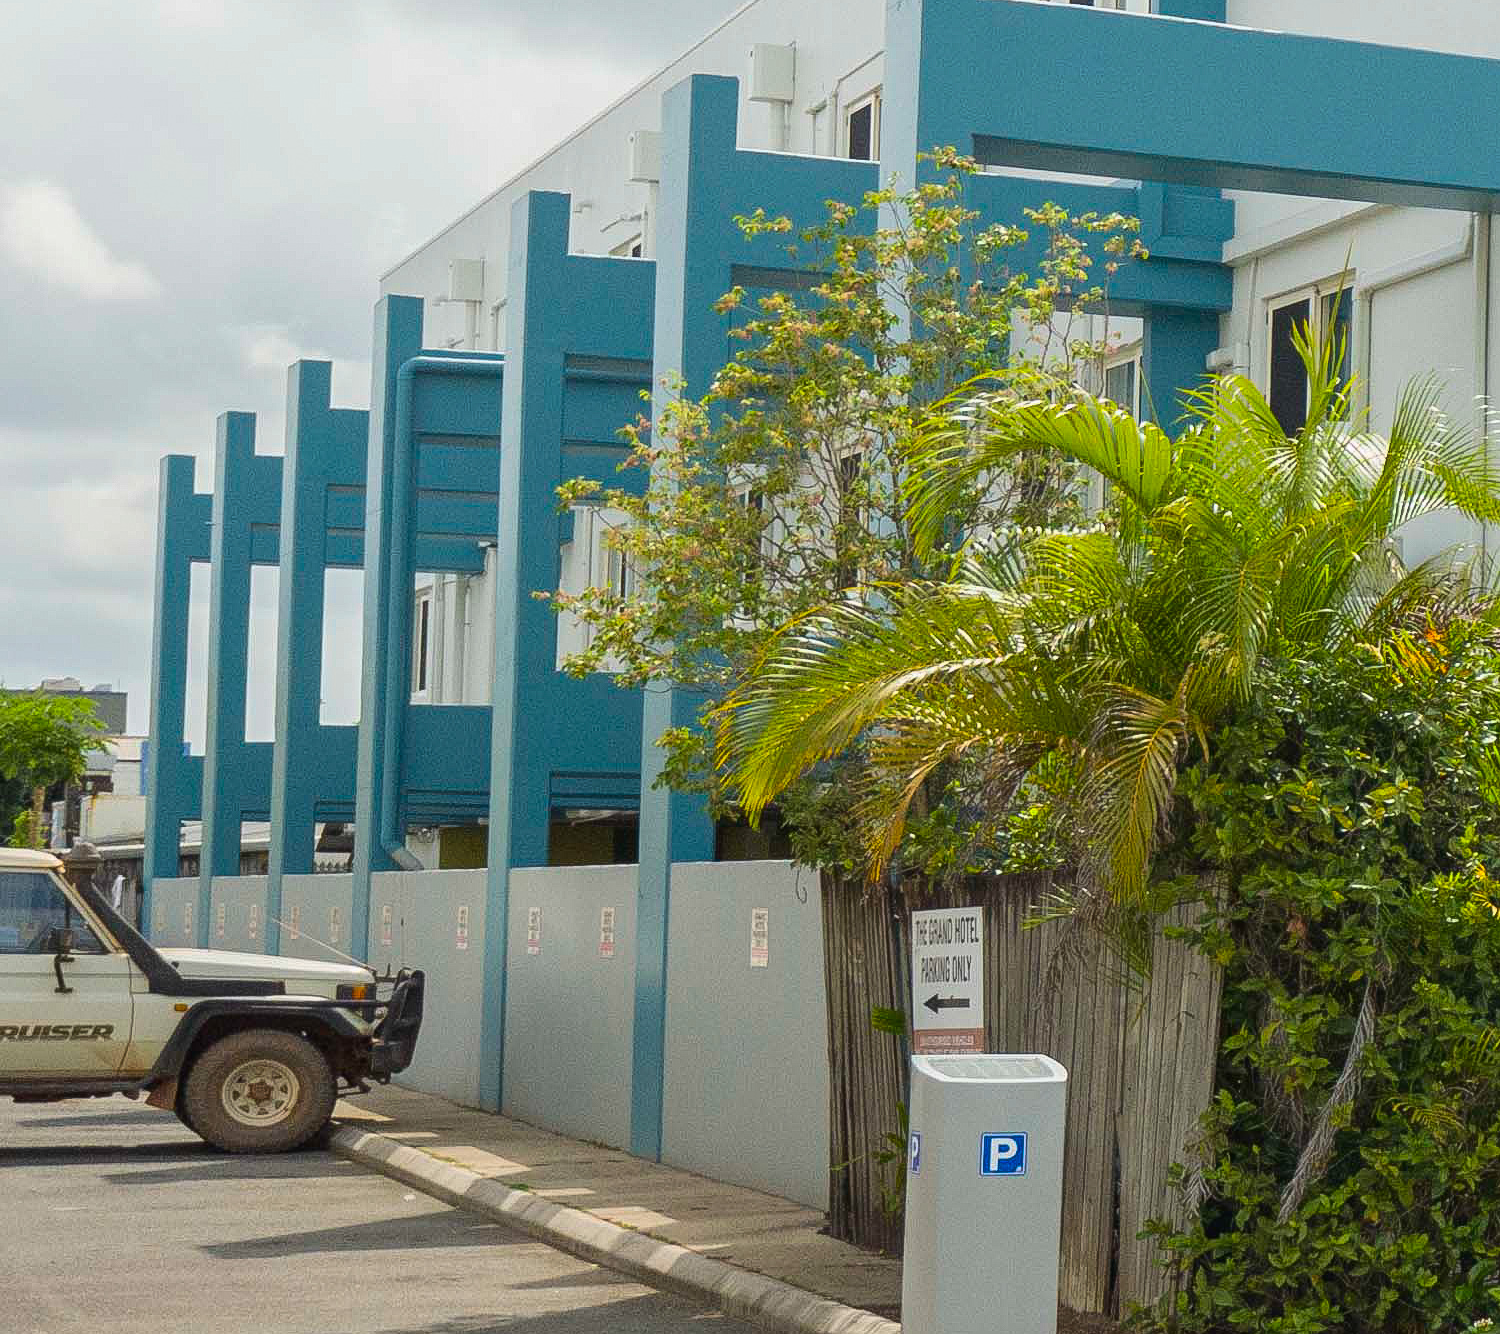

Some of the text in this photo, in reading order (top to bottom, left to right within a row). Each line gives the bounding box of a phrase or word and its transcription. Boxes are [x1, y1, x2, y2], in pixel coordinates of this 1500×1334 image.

[914, 916, 980, 946] THE GRAND HOTEL
[920, 954, 972, 983] PARKING ONLY
[990, 1136, 1018, 1172] P
